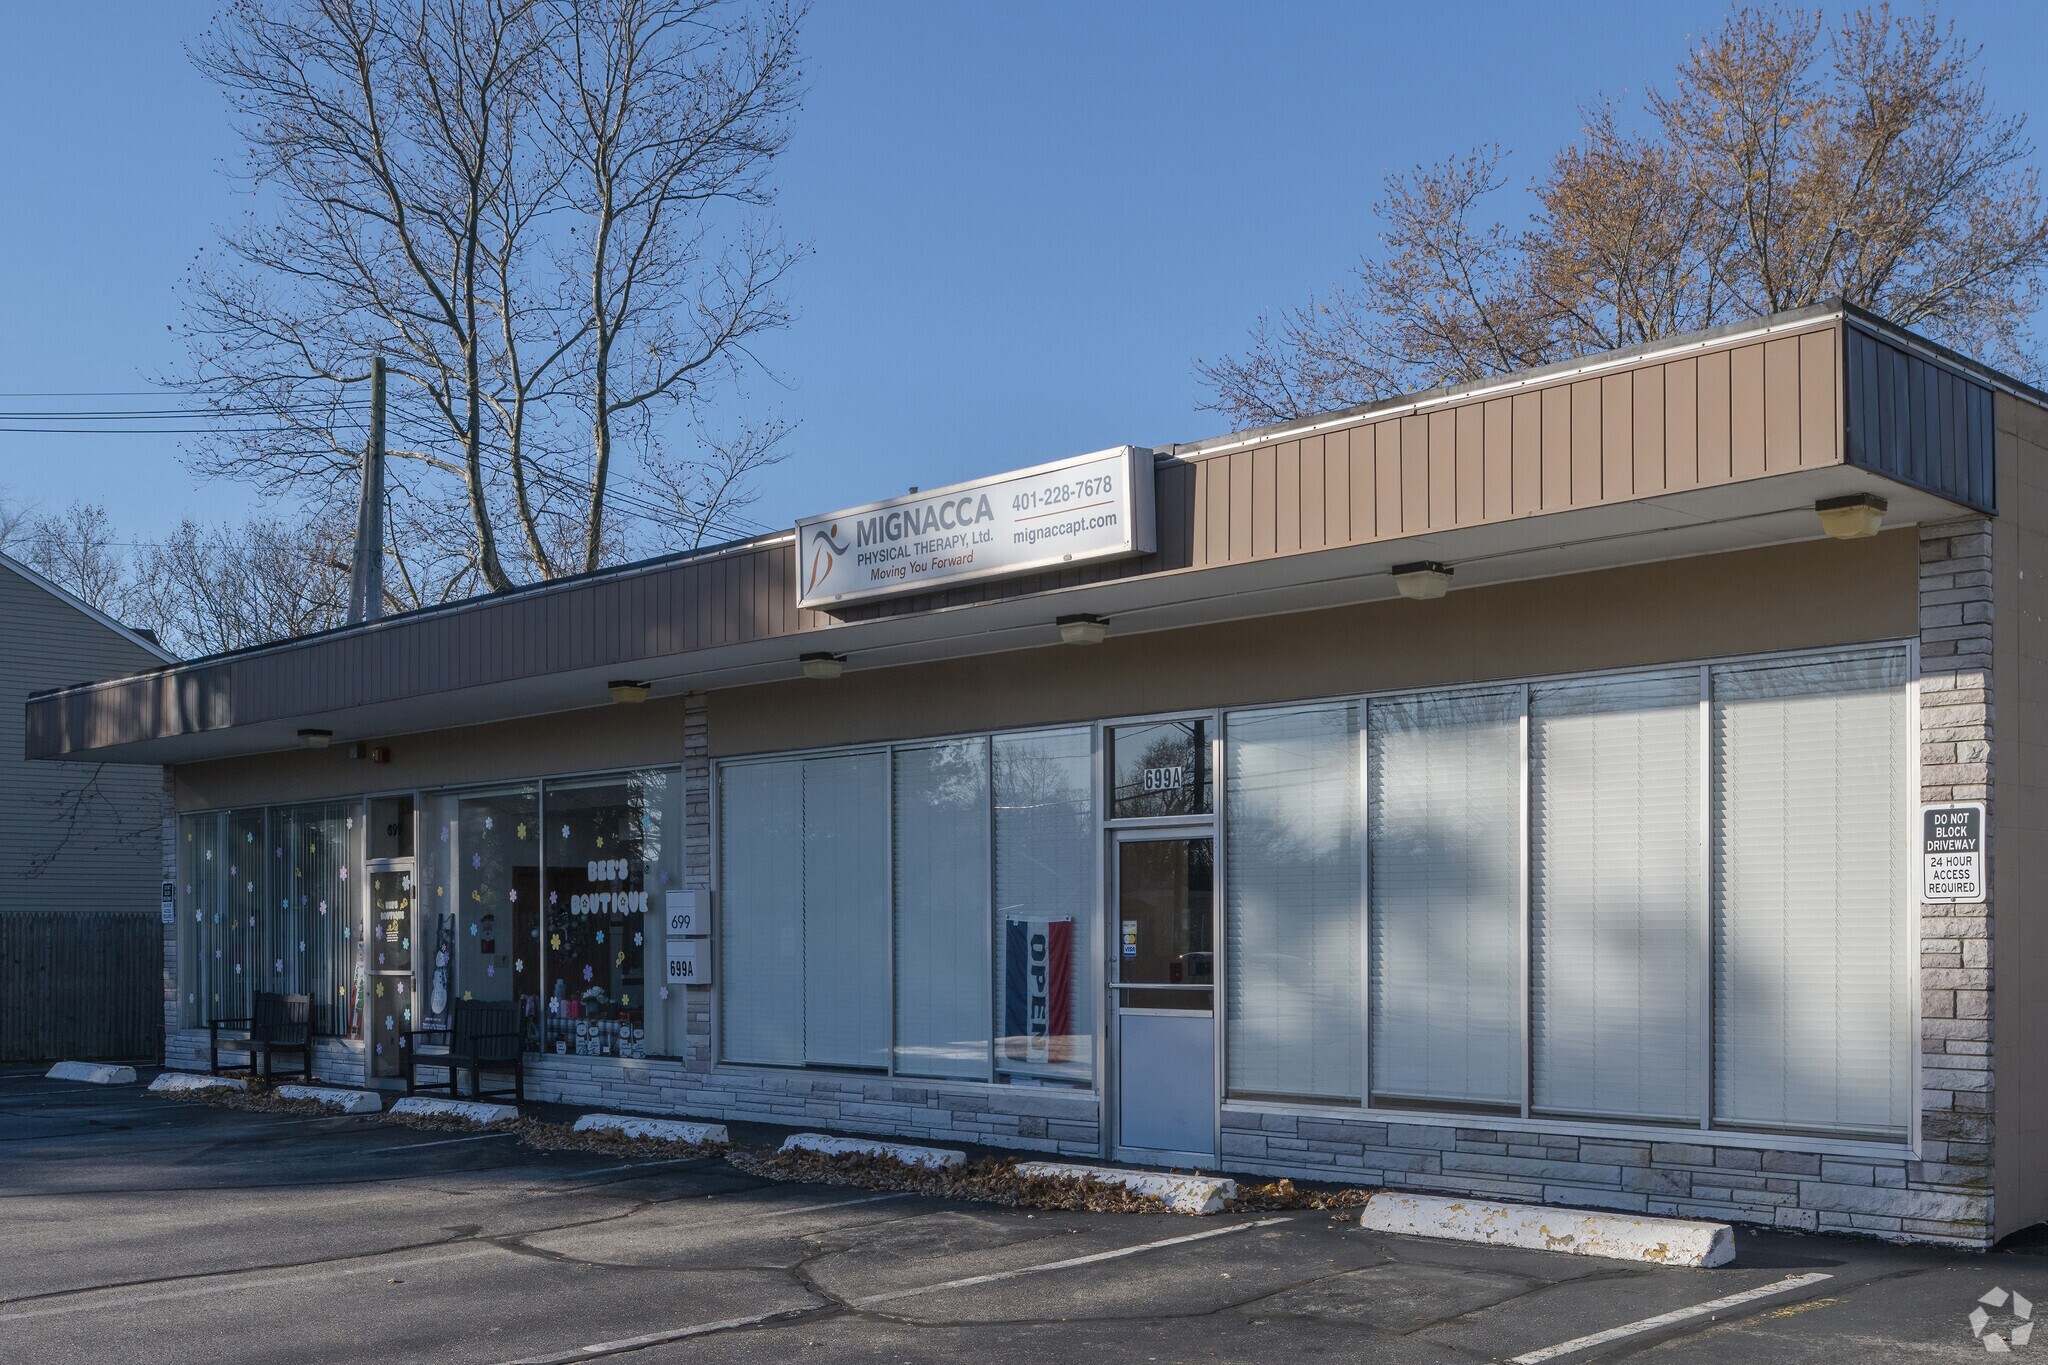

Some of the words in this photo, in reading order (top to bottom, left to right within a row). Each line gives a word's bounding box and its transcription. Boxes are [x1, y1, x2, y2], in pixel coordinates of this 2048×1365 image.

[1012, 475, 1112, 511] 401-228-7678
[857, 494, 994, 547] MIGNACCA
[1013, 513, 1117, 544] mignaccapt.com
[857, 544, 911, 566] PHYSICAL
[914, 533, 969, 555] THERAPY,
[973, 529, 994, 544] Ltd.
[870, 565, 906, 580] Moving
[909, 560, 927, 574] You
[932, 549, 974, 570] Forward
[1146, 768, 1180, 789] 699A
[1934, 814, 1948, 825] DO
[1950, 813, 1969, 824] NOT
[1936, 826, 1967, 838] BLOCK
[1927, 839, 1976, 851] DRIVEWAY
[588, 858, 628, 882] BEE'S
[1930, 857, 1943, 867] 24
[1946, 856, 1972, 867] HOUR
[1933, 869, 1970, 880] ACCESS
[1929, 882, 1975, 893] REQUIRED
[571, 891, 648, 916] BOUTIQUE
[671, 915, 691, 929] 699
[670, 961, 693, 977] 699A
[1031, 934, 1046, 1050] OPEN
